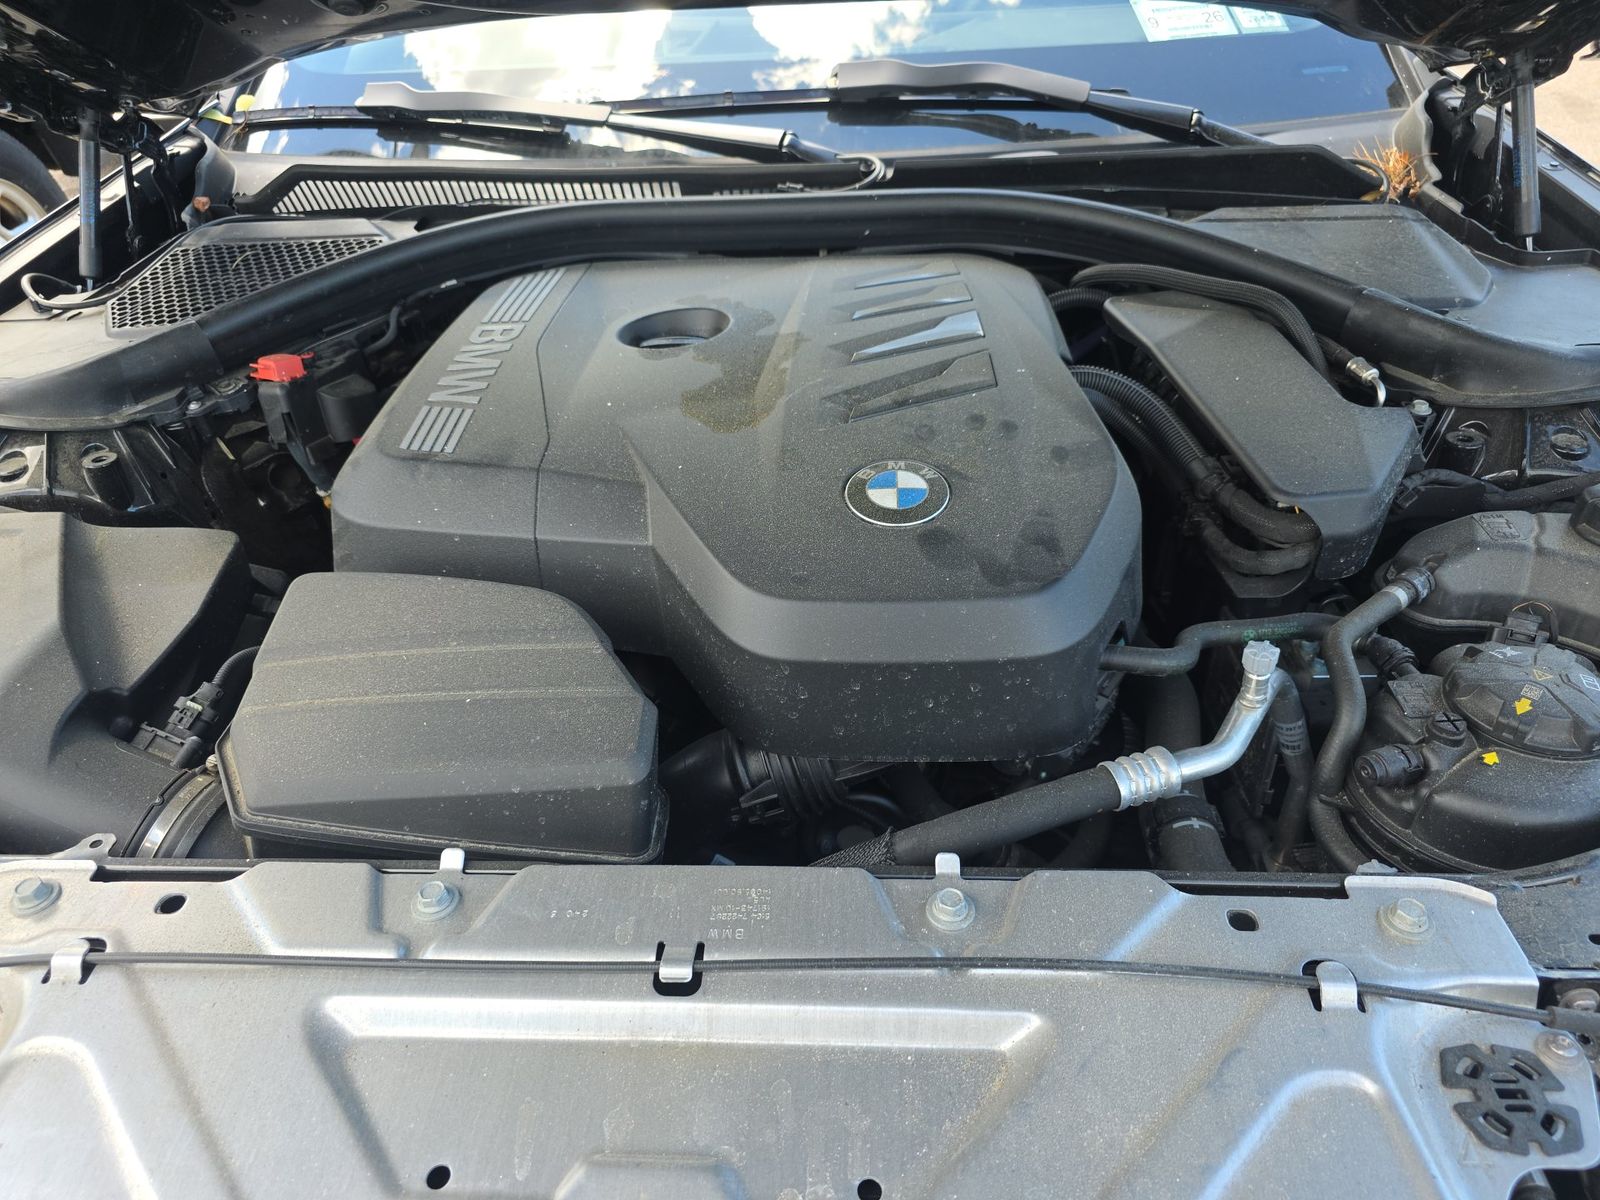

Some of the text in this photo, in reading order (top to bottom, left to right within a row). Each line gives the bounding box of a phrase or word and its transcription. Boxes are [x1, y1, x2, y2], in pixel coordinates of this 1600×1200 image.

[1148, 16, 1159, 29] 9
[1201, 11, 1224, 23] 26
[428, 323, 526, 404] BMW
[857, 461, 939, 480] BMW
[707, 928, 744, 939] BMW
